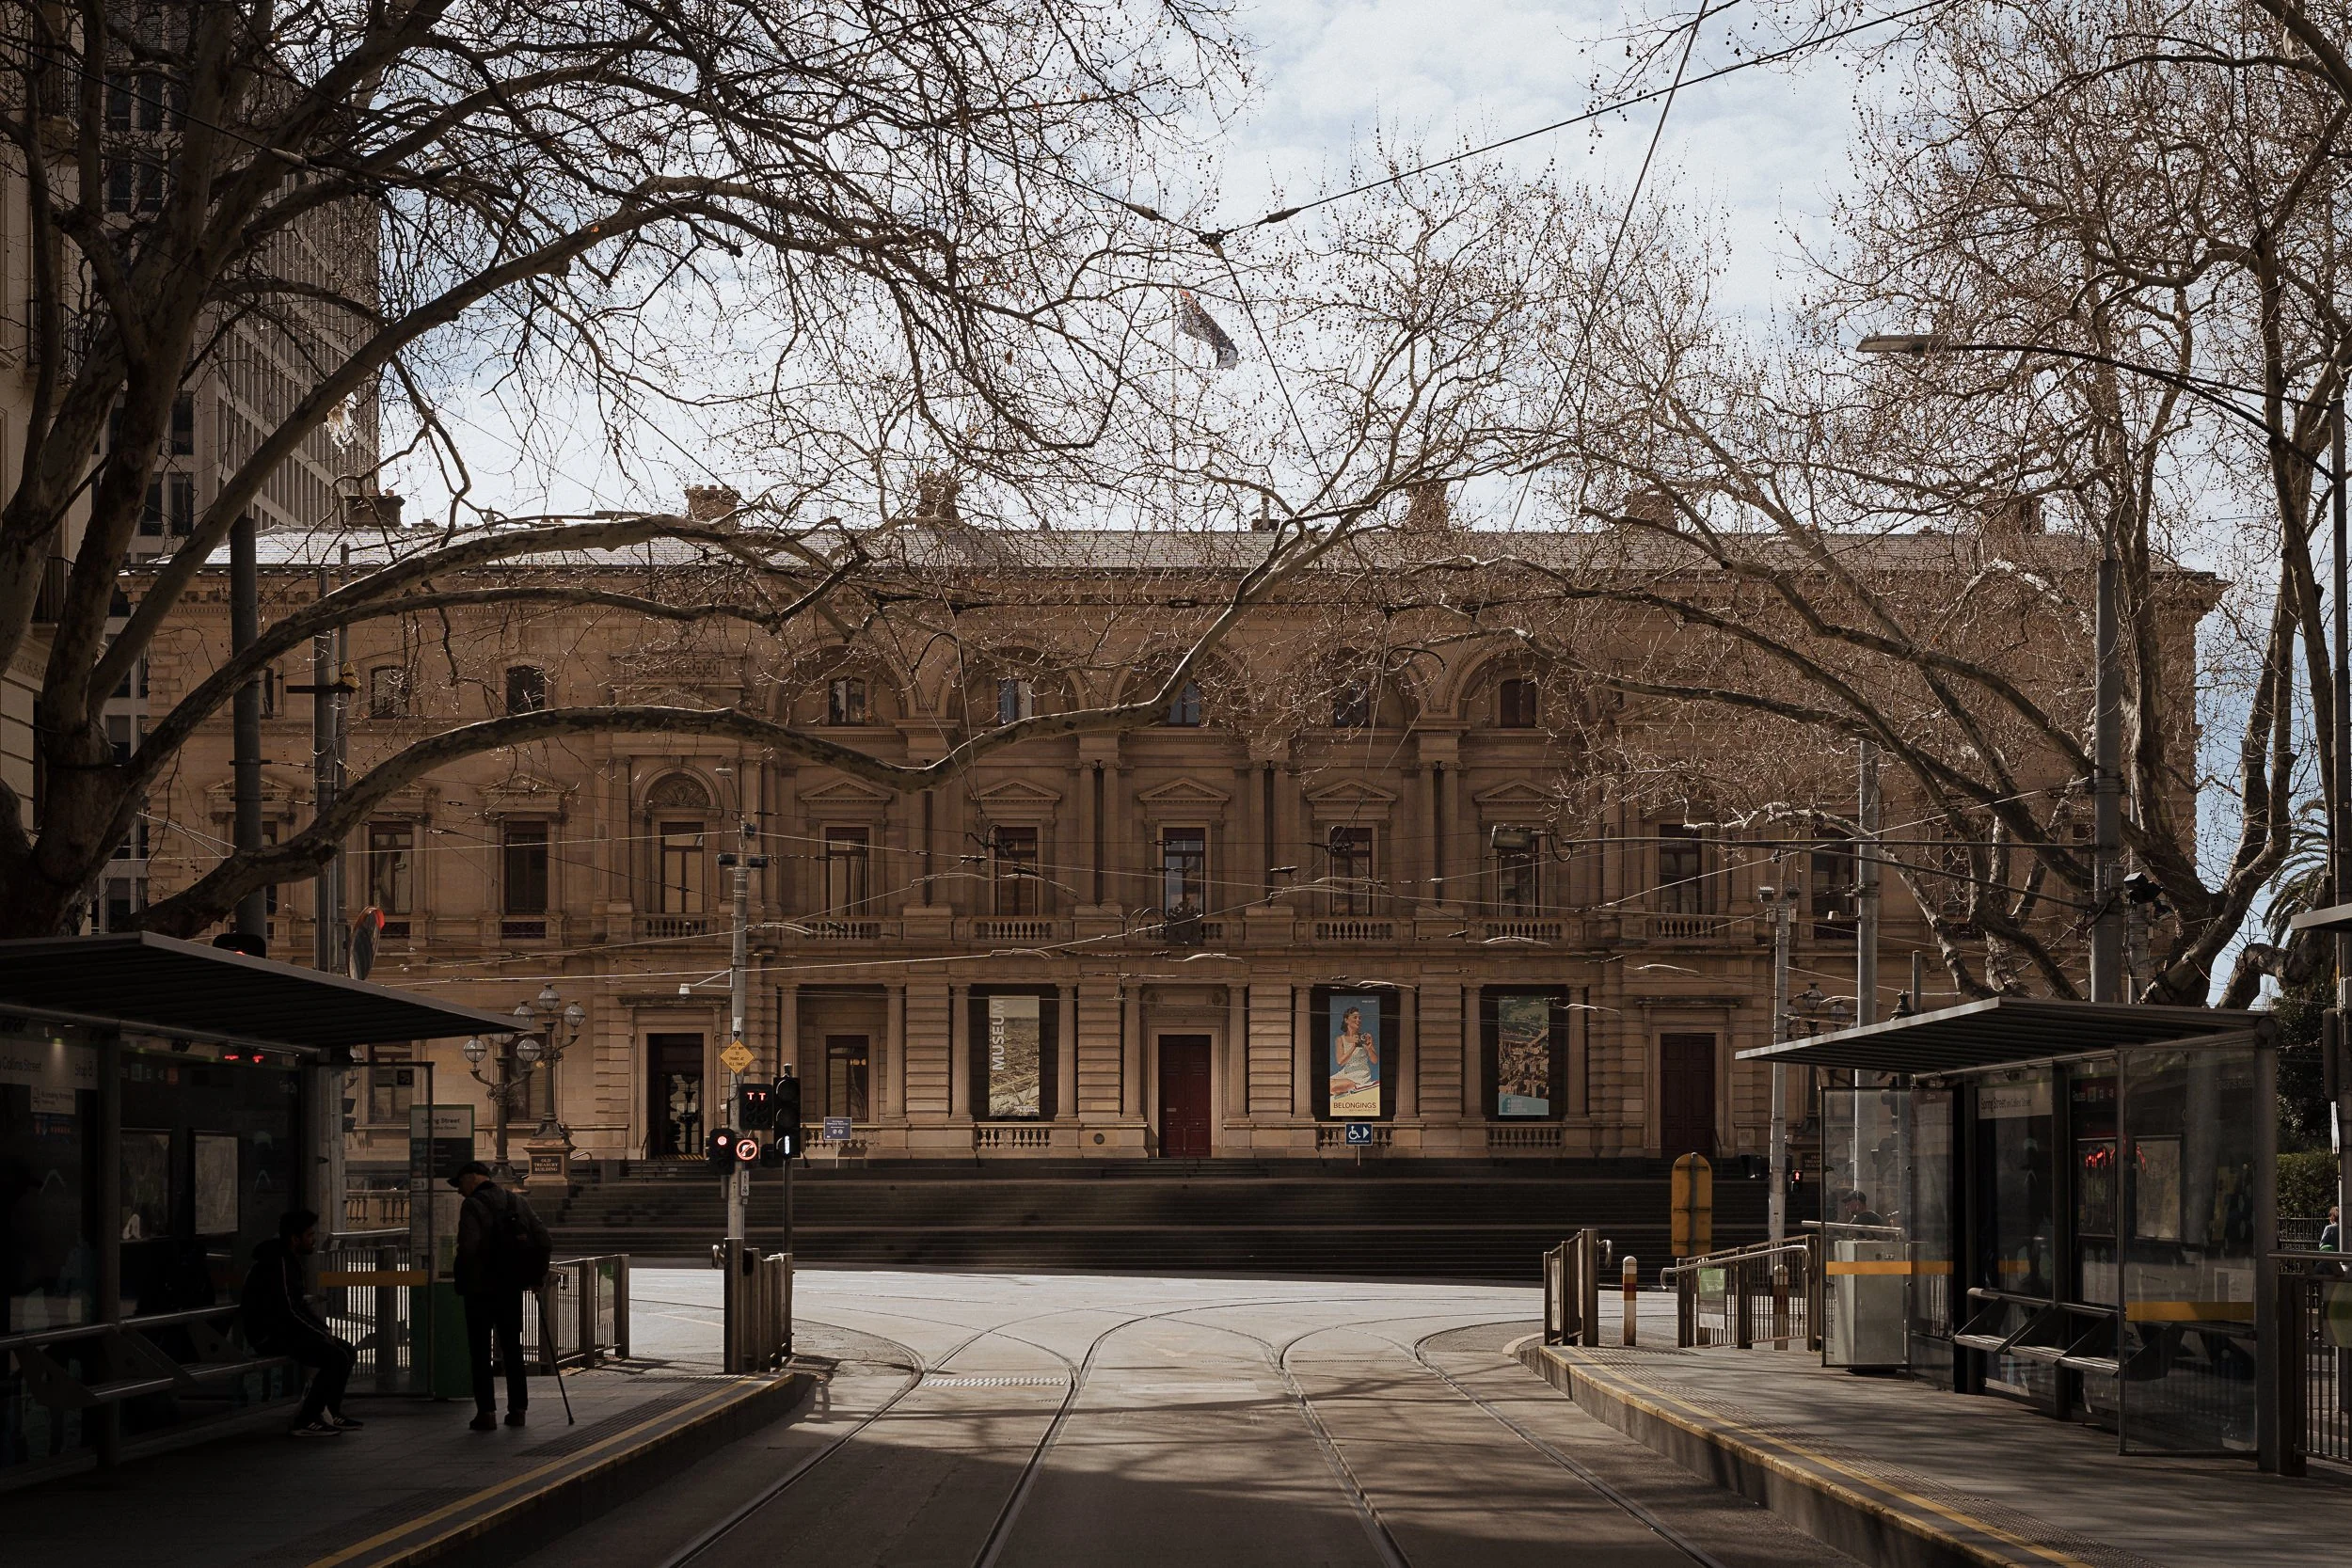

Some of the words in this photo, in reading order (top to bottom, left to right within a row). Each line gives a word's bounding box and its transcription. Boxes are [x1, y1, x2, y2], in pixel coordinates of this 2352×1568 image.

[992, 999, 1005, 1070] MUSEUM
[1980, 1097, 1994, 1112] Spring
[1994, 1097, 2007, 1108] Street
[421, 1117, 439, 1126] Spng
